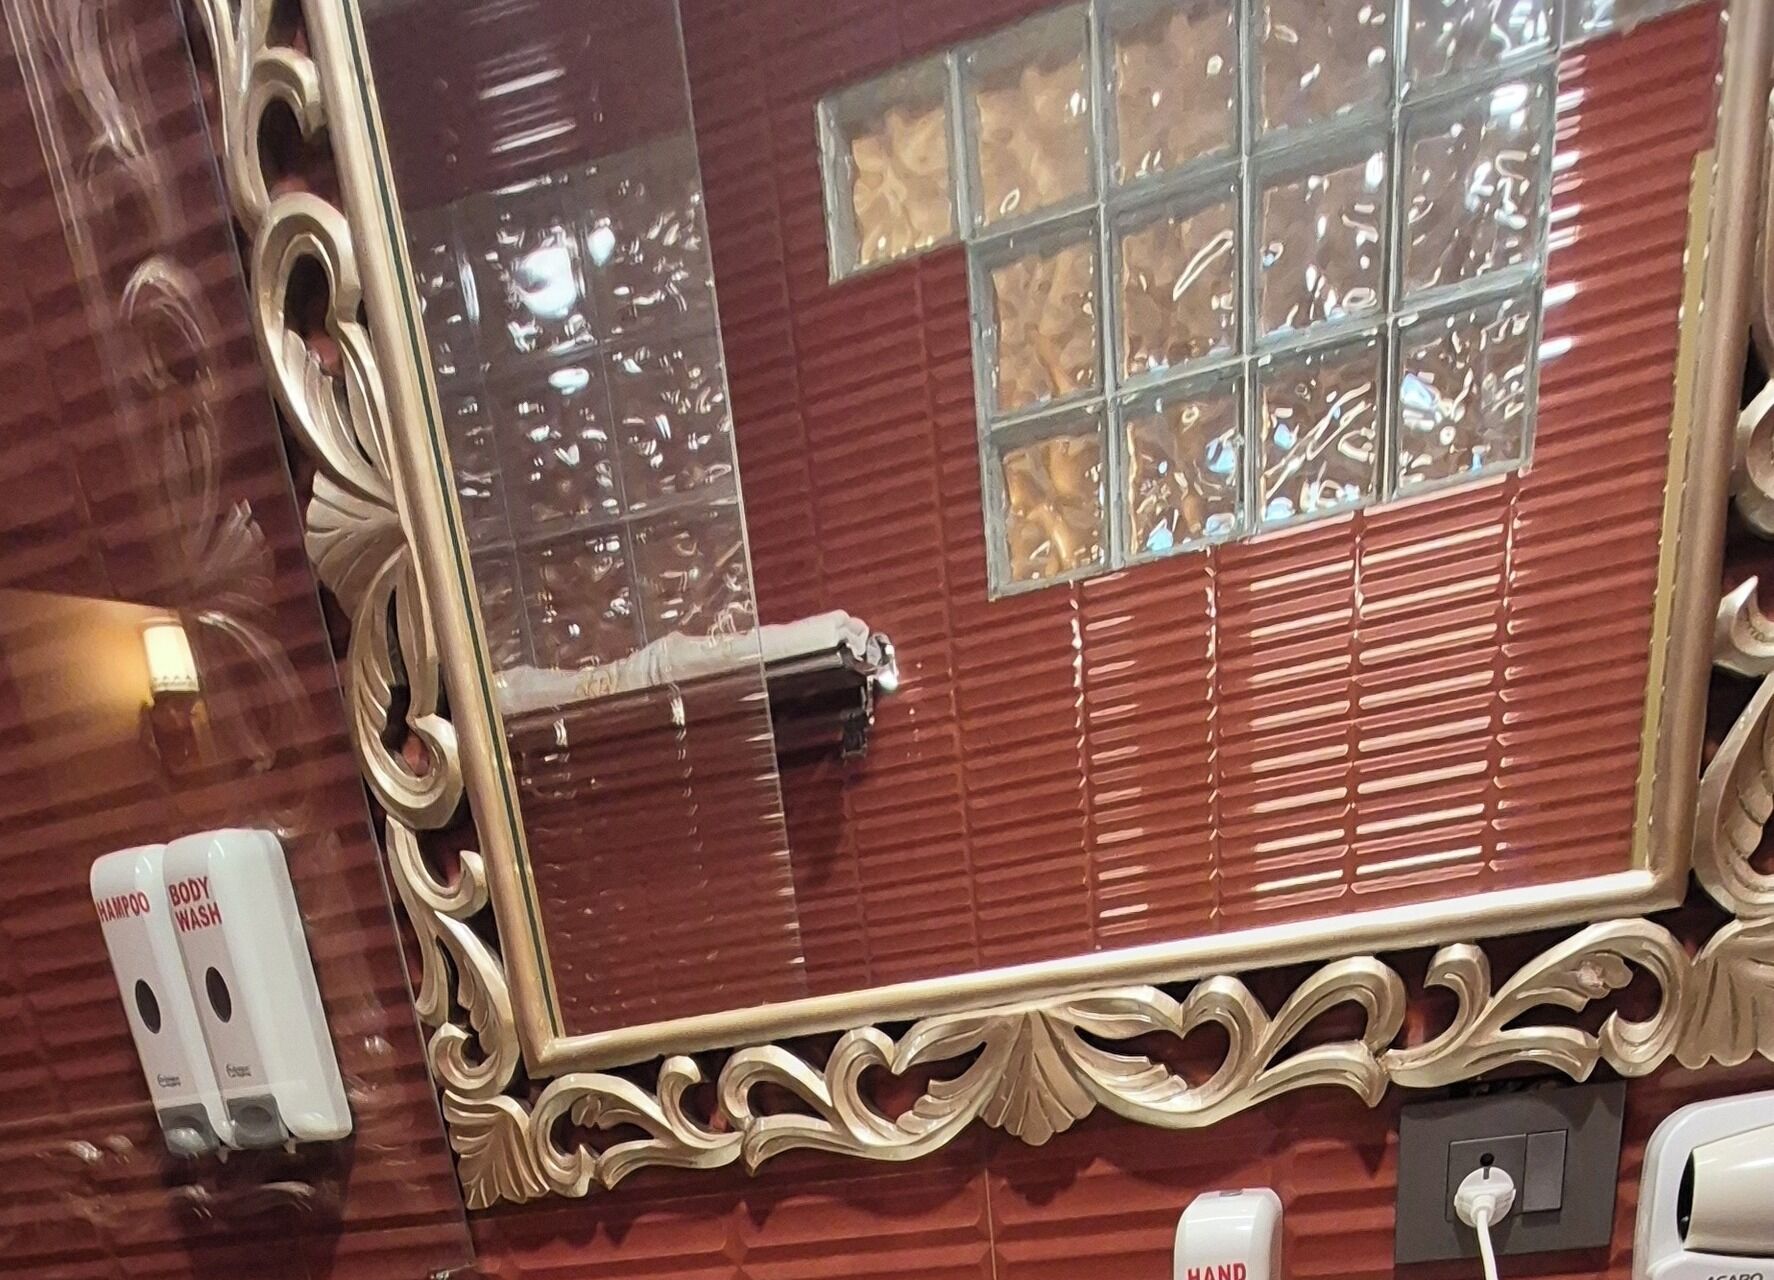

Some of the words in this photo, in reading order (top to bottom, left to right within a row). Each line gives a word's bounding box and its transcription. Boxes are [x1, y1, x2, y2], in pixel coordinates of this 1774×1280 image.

[168, 876, 210, 906] BODY
[97, 892, 150, 922] HAMPOO
[175, 902, 222, 932] WASH
